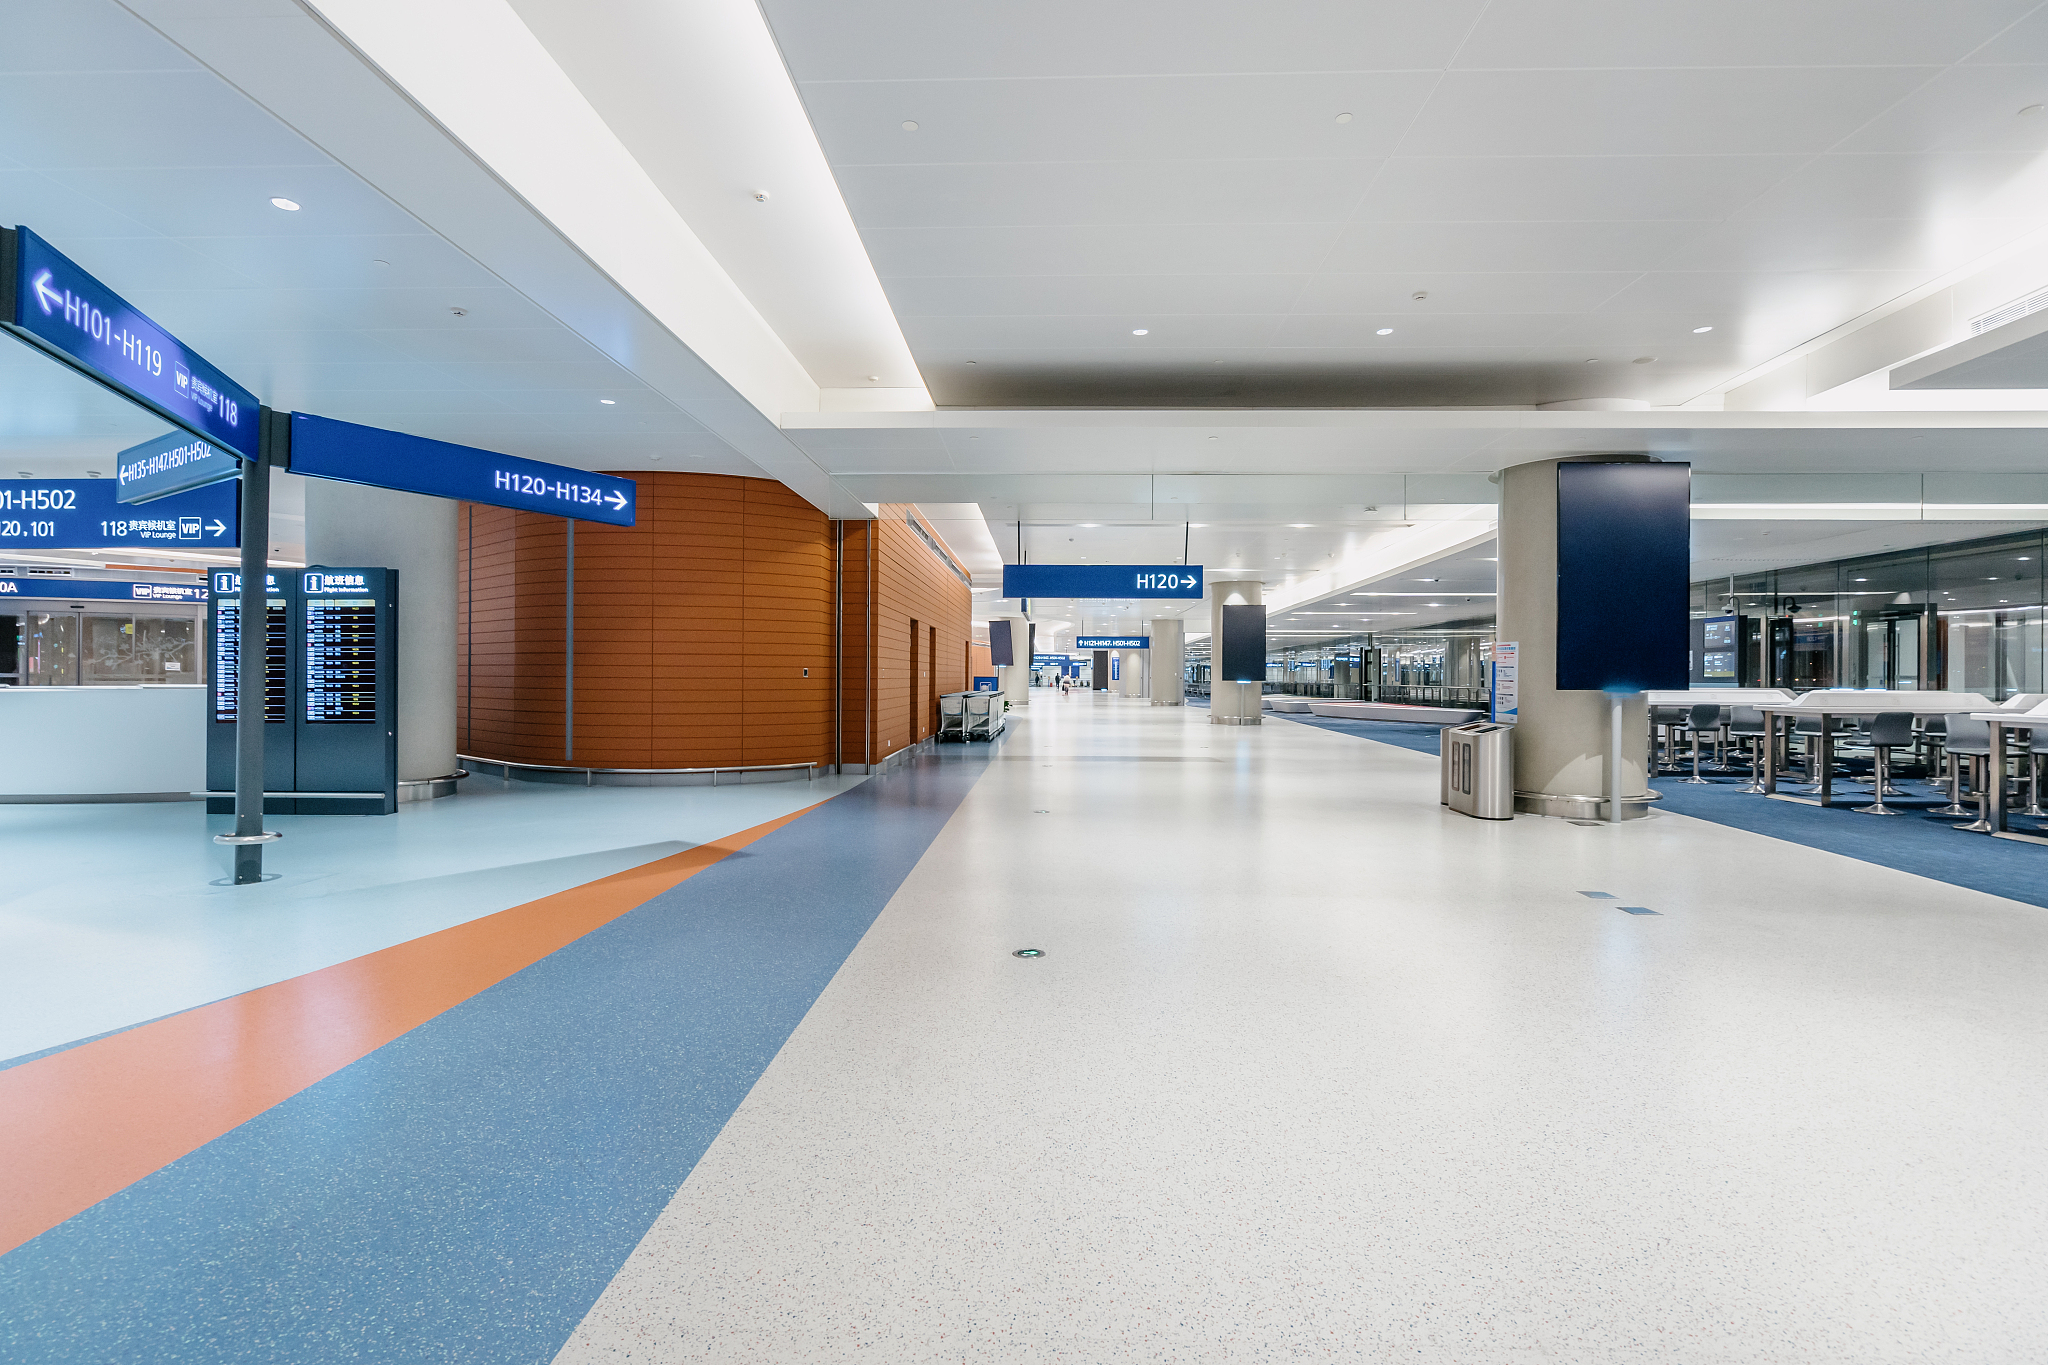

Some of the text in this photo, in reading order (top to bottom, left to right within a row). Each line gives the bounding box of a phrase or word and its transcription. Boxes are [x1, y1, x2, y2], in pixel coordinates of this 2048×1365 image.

[64, 289, 163, 376] H101-H119
[176, 369, 189, 389] VIP
[219, 395, 237, 427] 118
[494, 470, 603, 506] H120-H134
[100, 519, 200, 537] 118 贵宾候机室 VIP
[140, 531, 177, 540] VIP Lounge
[1136, 573, 1179, 590] H120
